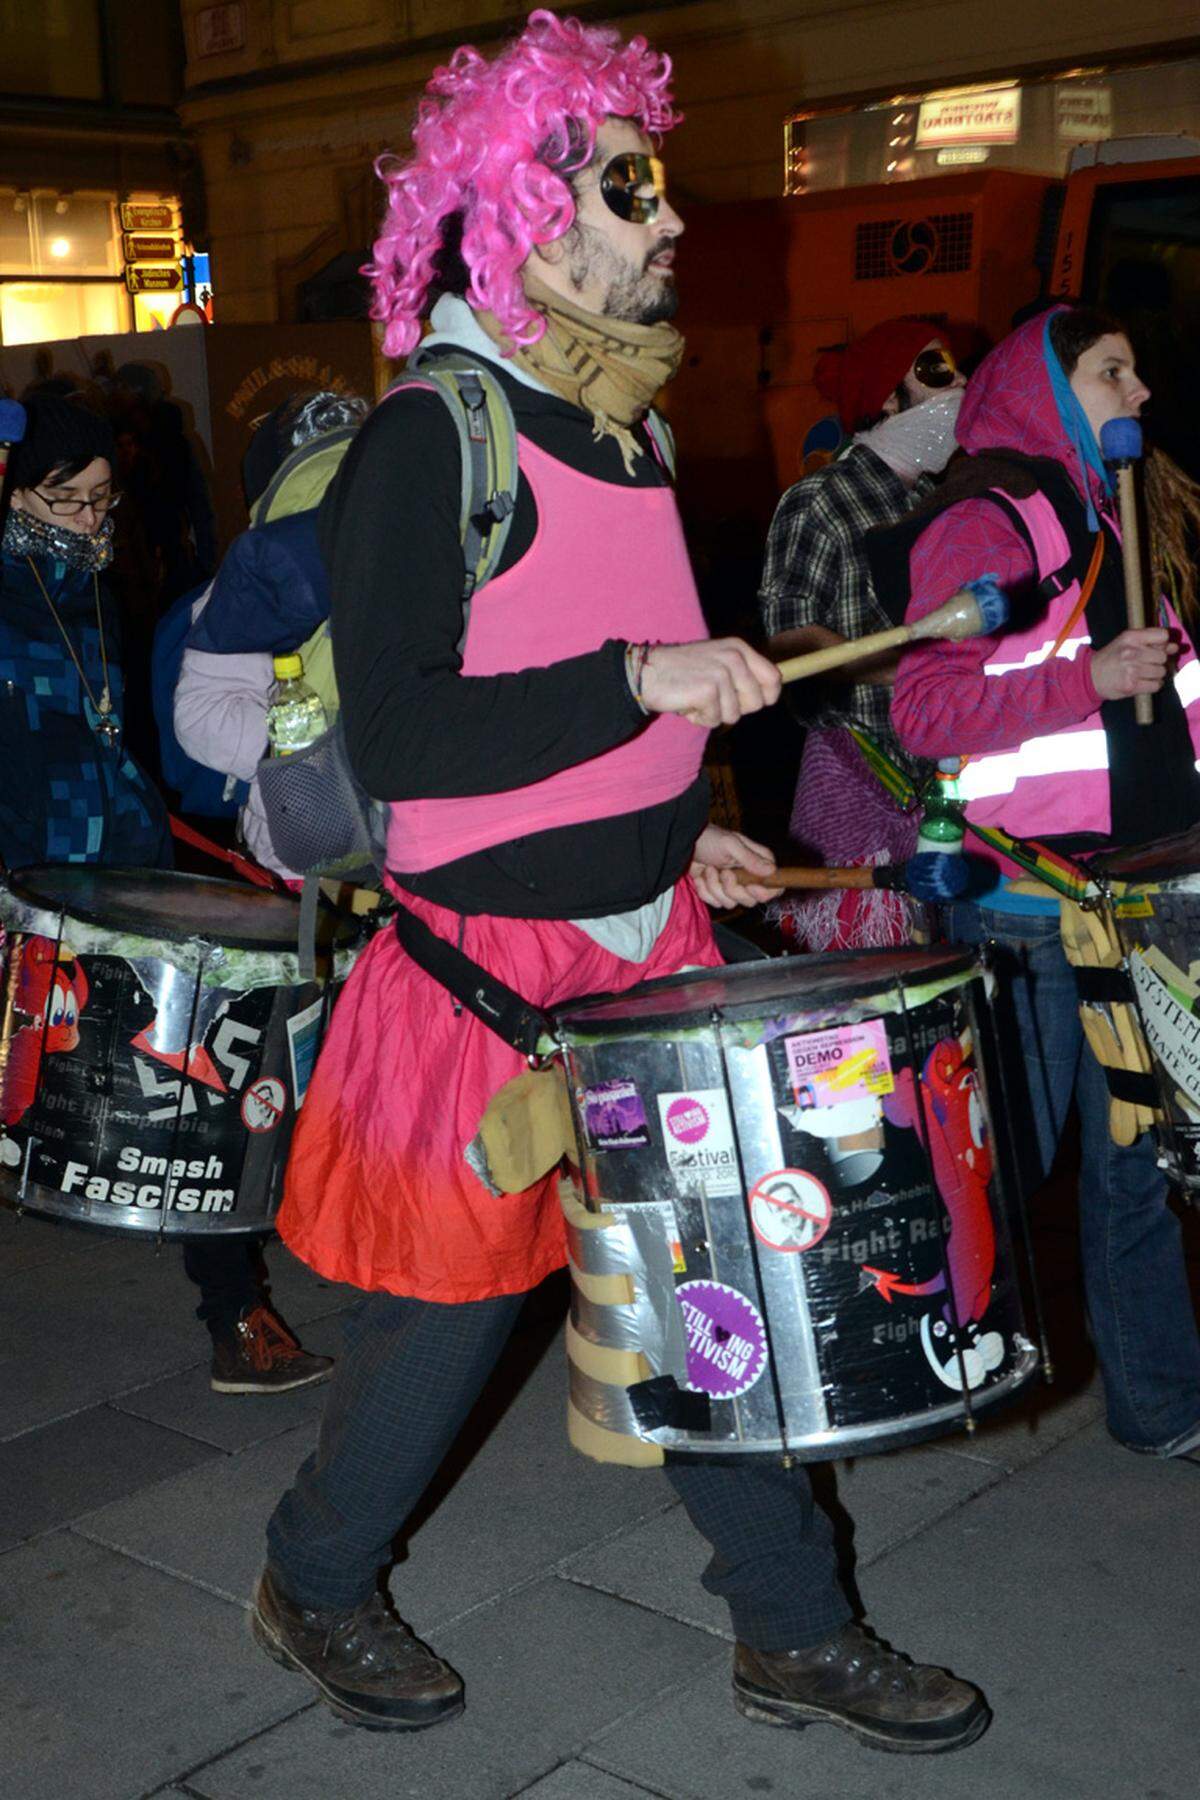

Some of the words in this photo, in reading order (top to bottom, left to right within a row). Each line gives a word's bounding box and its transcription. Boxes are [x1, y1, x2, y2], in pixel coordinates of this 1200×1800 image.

[795, 1047, 843, 1067] DEMO
[1179, 1044, 1200, 1072] NO
[117, 1146, 223, 1179] Smash
[60, 1160, 235, 1212] Fascism
[820, 1229, 901, 1265] Fight
[685, 1322, 748, 1380] TIVISM
